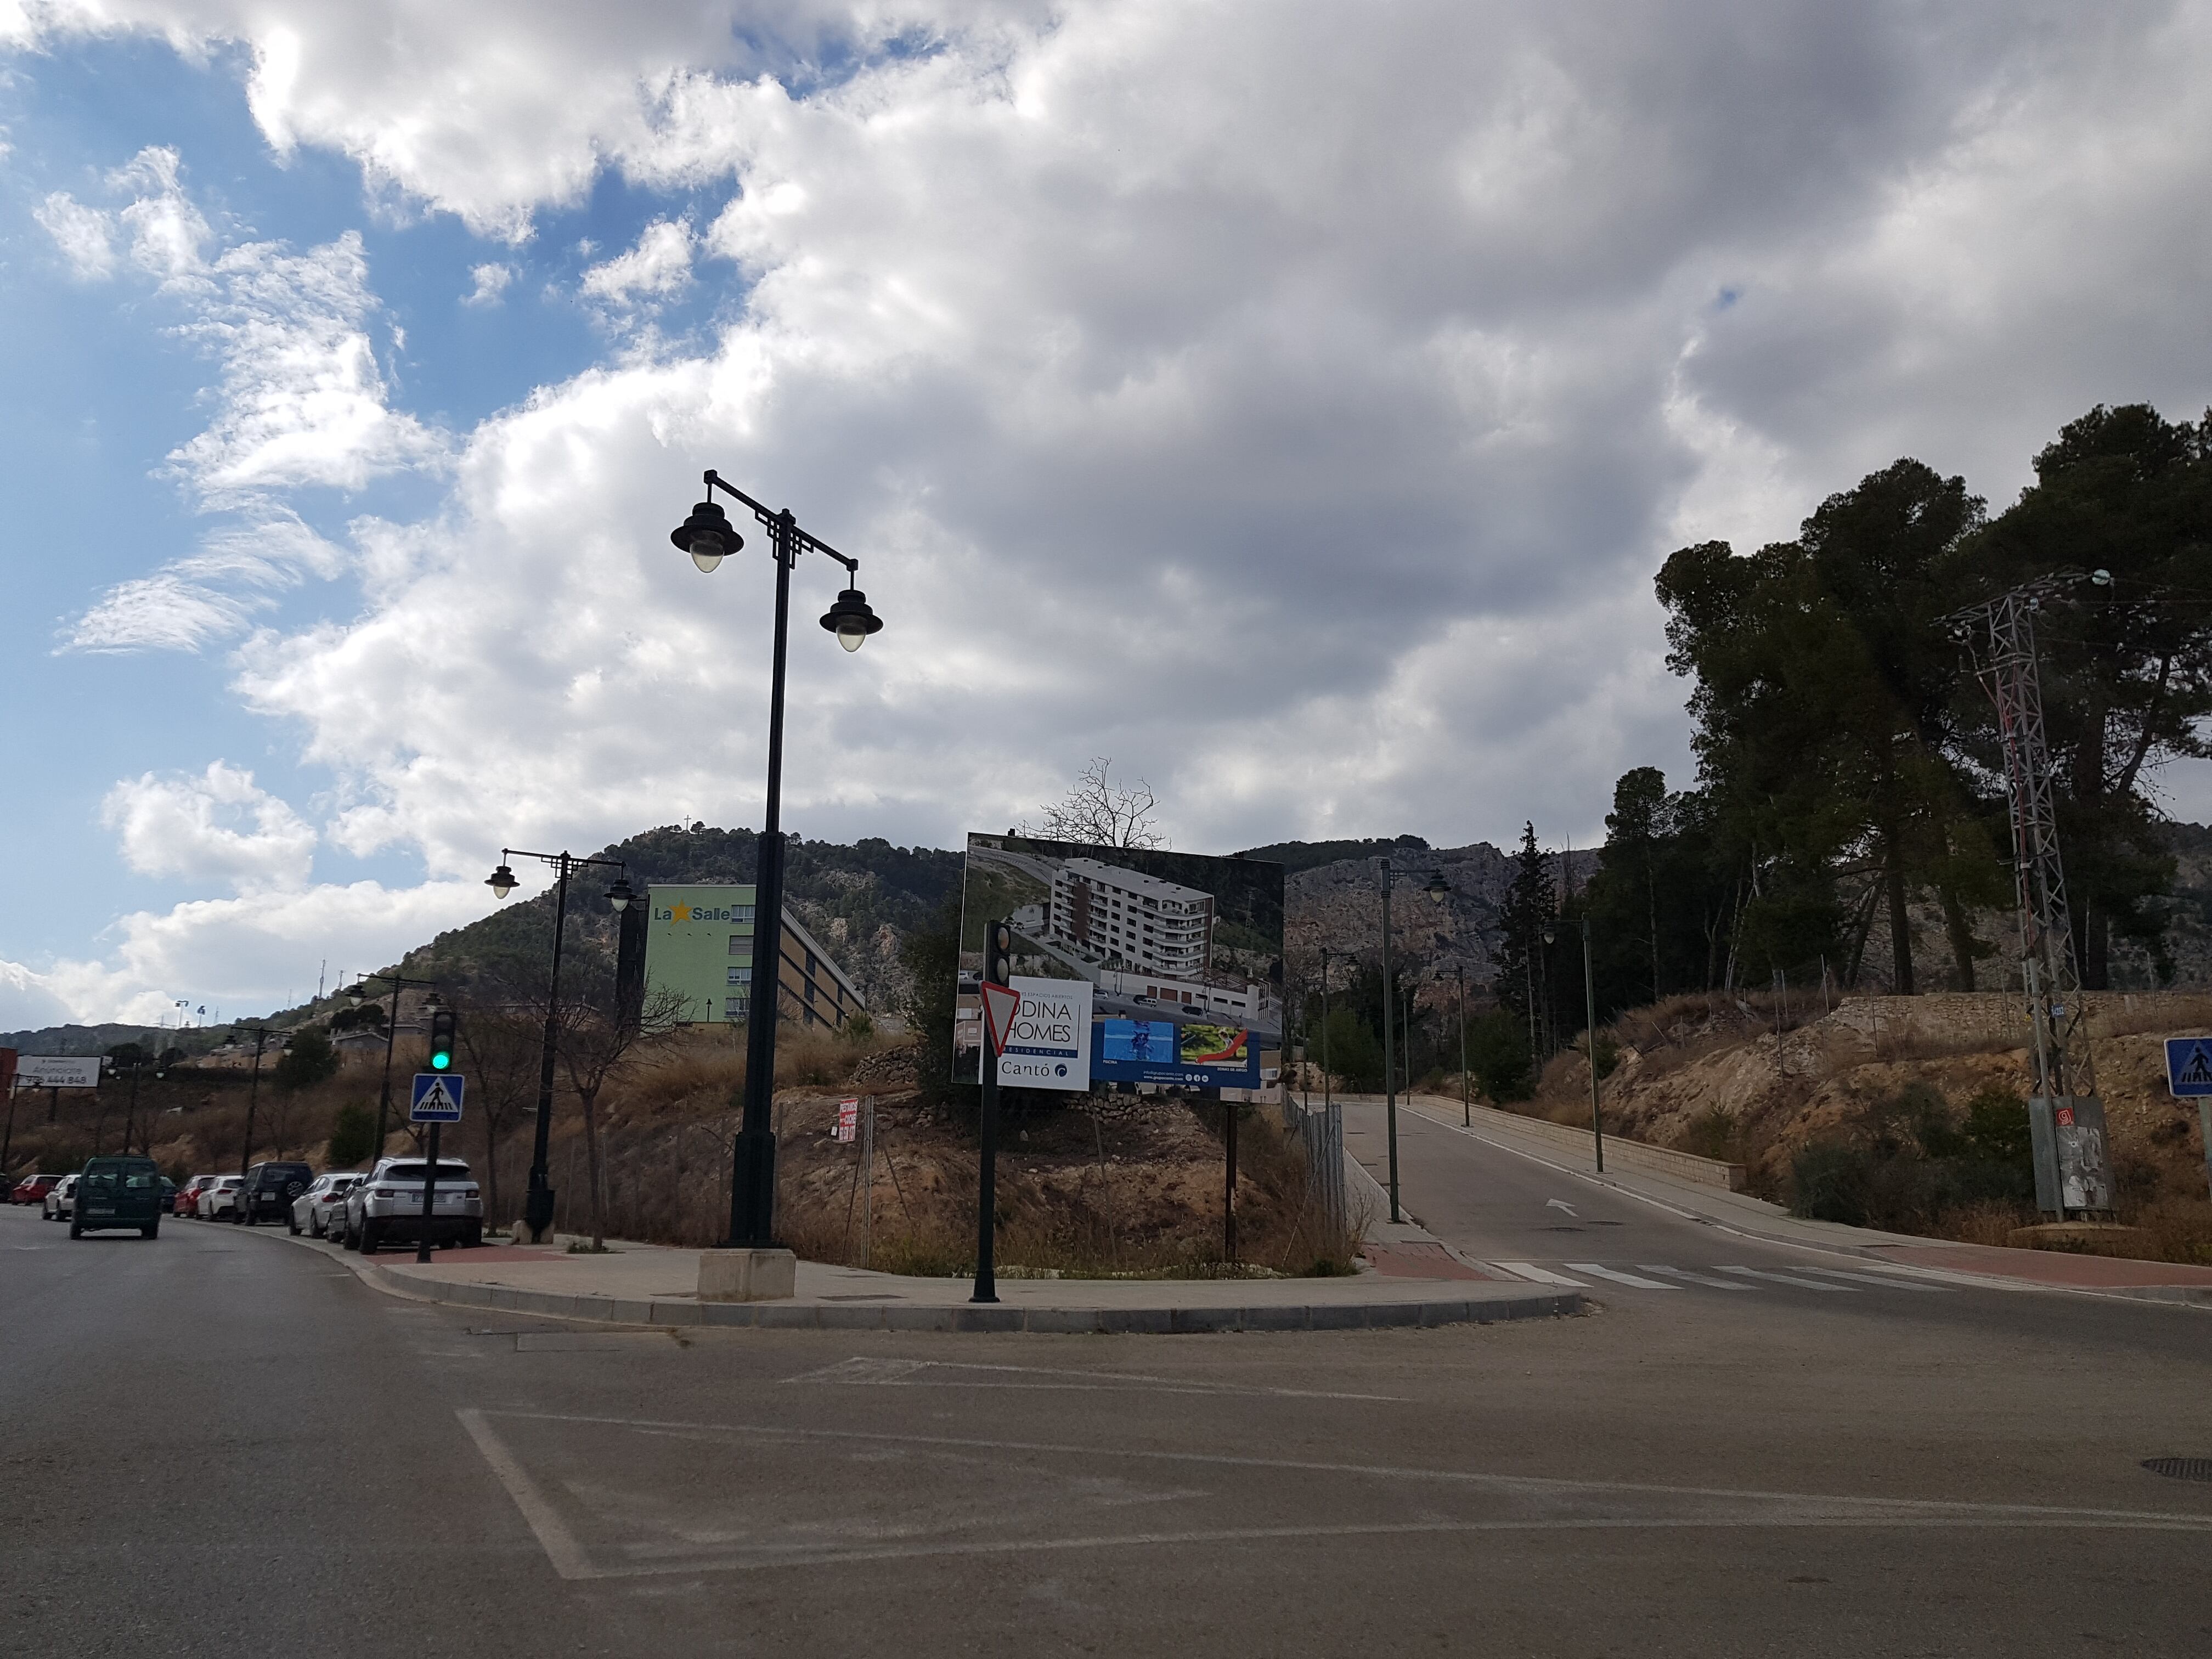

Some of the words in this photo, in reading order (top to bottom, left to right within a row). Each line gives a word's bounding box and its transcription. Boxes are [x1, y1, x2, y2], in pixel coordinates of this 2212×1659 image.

[654, 907, 672, 920] La
[692, 907, 730, 921] Salle
[1002, 1061, 1049, 1076] Cantó
